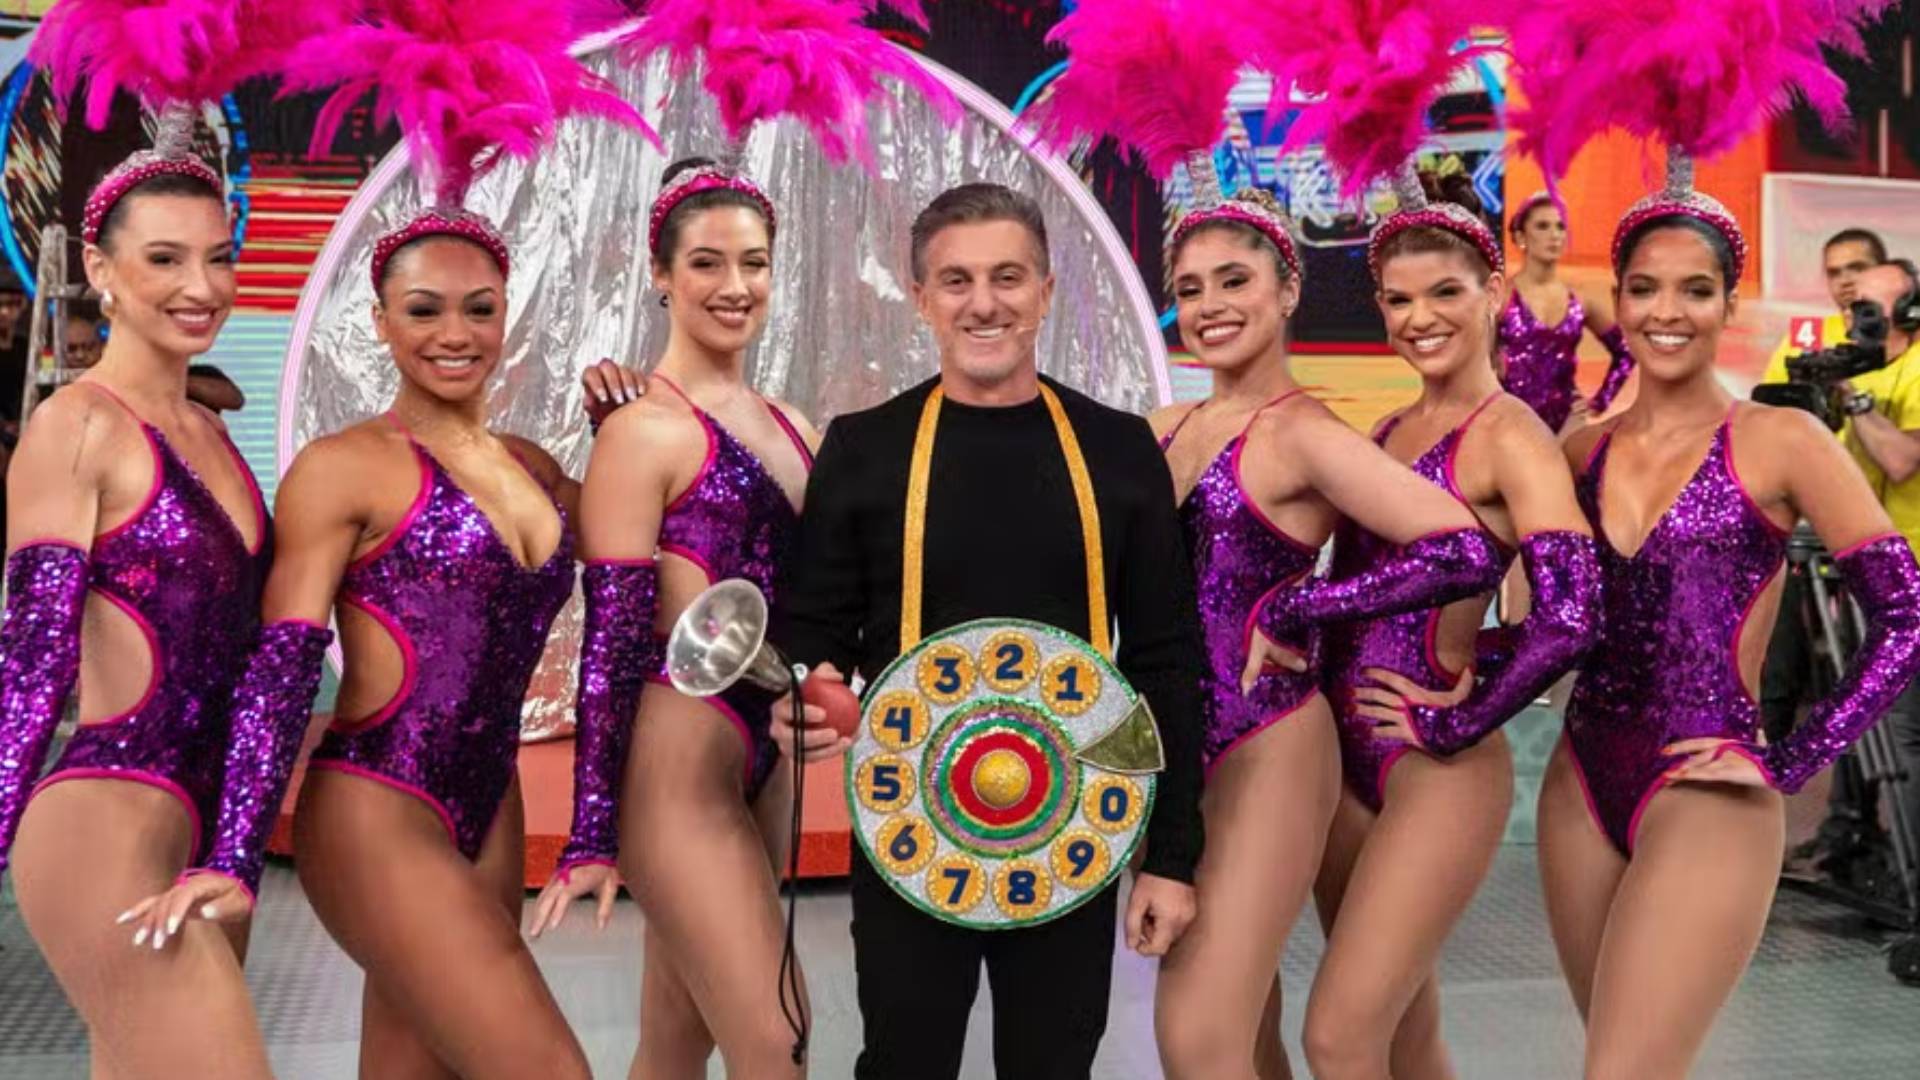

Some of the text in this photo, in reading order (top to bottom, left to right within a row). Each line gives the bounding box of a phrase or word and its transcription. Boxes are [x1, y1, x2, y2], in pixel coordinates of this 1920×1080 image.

[1796, 321, 1815, 346] 4
[935, 658, 960, 693] 3
[996, 644, 1023, 679] 2
[1057, 667, 1083, 700] 1
[884, 707, 911, 742] 4
[872, 766, 900, 800] 5
[1100, 787, 1127, 821] 0
[890, 825, 917, 860] 6
[1067, 841, 1094, 877] 9
[943, 869, 970, 903] 7
[1008, 870, 1035, 904] 8
